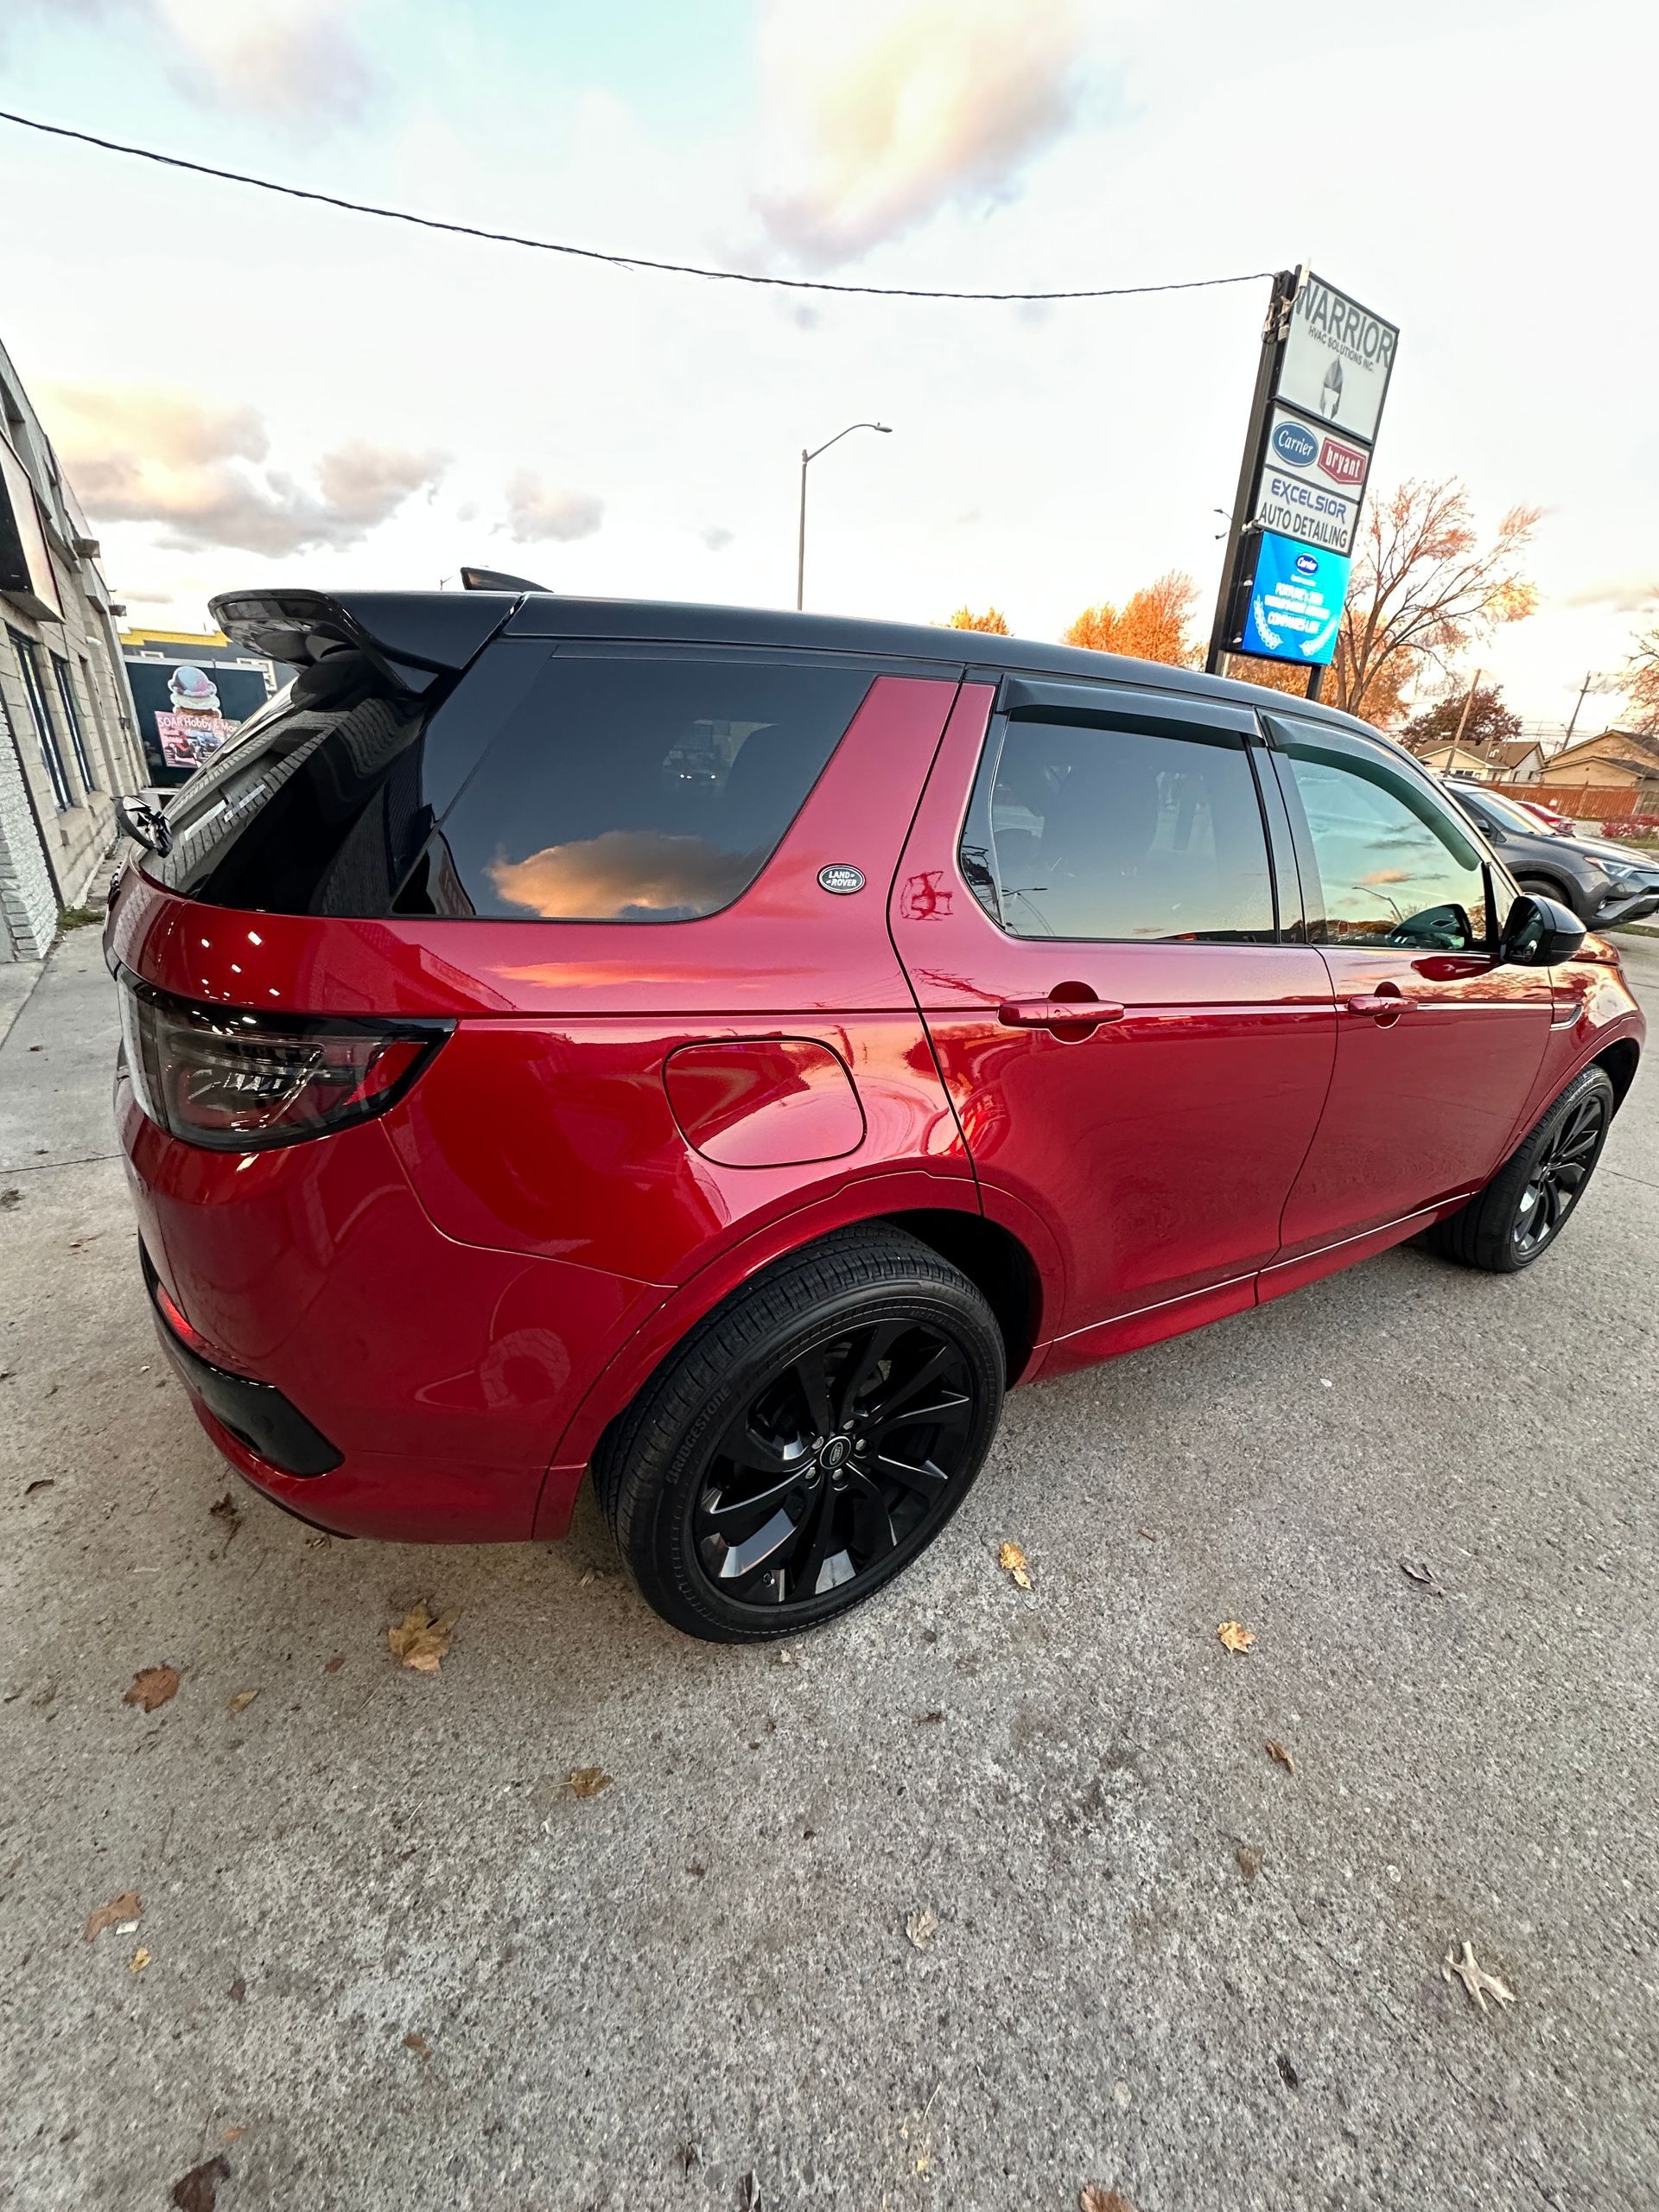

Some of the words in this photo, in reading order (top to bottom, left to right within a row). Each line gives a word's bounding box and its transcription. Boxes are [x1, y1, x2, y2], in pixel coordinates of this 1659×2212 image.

[1295, 279, 1393, 368] WARRIOR
[1308, 325, 1327, 345] HVAC
[1327, 336, 1363, 366] SOLUTIONS
[1278, 429, 1313, 456] Carrier
[1325, 446, 1361, 478] bryant
[1271, 478, 1346, 524] EXCELSIOR
[1259, 501, 1291, 530] AUTO
[1293, 513, 1348, 548] DETAILING
[159, 716, 183, 727] SOAR
[184, 718, 212, 729] Hobby
[222, 722, 238, 732] Mor
[828, 870, 850, 879] LAND
